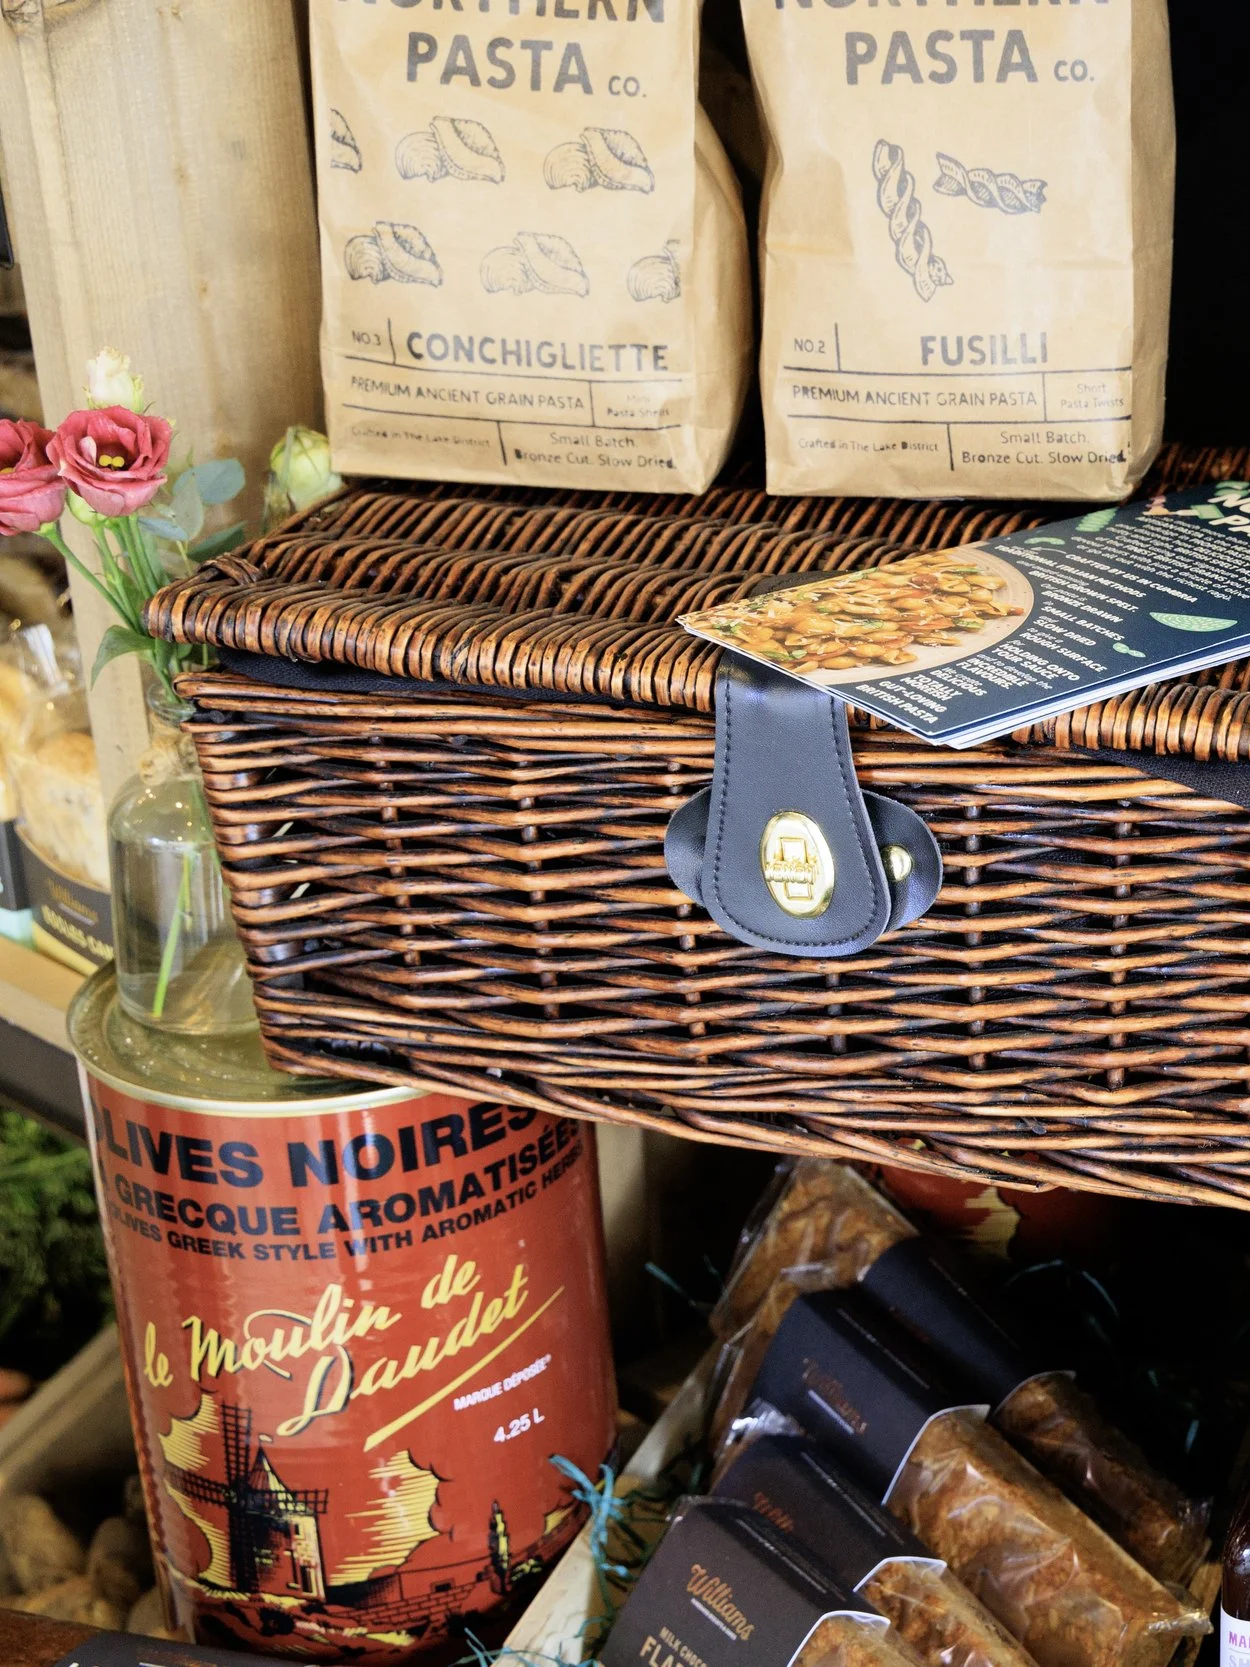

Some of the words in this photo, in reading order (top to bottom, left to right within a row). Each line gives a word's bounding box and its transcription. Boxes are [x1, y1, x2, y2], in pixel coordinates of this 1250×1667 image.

[406, 32, 593, 95] PASTA
[608, 76, 647, 98] CO.
[845, 29, 1038, 85] PASTA
[1054, 60, 1095, 82] CO.
[407, 332, 668, 372] CONCHIGLIETTE
[920, 332, 1048, 366] FUSILLI
[351, 376, 411, 398] PREMIUM
[416, 386, 480, 404] ANCIENT
[486, 391, 534, 407] GRAIN
[538, 395, 585, 410] PASTA
[793, 385, 859, 403] PREMIUM
[865, 391, 931, 406] ANCIENT
[937, 392, 985, 406] GRAIN
[989, 391, 1037, 406] PASTA
[551, 432, 591, 447] Small
[1000, 431, 1041, 445] Small
[599, 455, 632, 467] Slow
[962, 451, 1010, 464] Bronze
[1048, 452, 1083, 464] Slow
[1029, 571, 1068, 585] BRITISH
[1068, 584, 1107, 599] GROWN
[1057, 565, 1096, 579] ITALIAN
[1096, 578, 1146, 597] METHODS
[1066, 554, 1110, 570] CRAFTED
[1107, 567, 1124, 576] BY
[1122, 572, 1138, 581] US
[1149, 584, 1198, 602] CUMBRIA
[1042, 606, 1078, 621] SMALL
[1077, 620, 1124, 640] BATCHES
[1043, 591, 1082, 607] BRONZE
[1081, 606, 1122, 622] DRAWN
[1034, 620, 1066, 633] SLOW
[1064, 632, 1096, 646] DRIED
[991, 649, 1023, 662] YOUR
[1021, 662, 1057, 679] SAUCE
[1001, 644, 1048, 665] HOLDING
[1047, 665, 1081, 681] ONTO
[1021, 633, 1059, 649] ROUGH
[1057, 648, 1107, 672] SURFACE
[914, 675, 961, 697] TOTALLY
[932, 670, 987, 696] DELICIOUS
[957, 662, 1014, 689] FLAVOURS.
[969, 658, 1027, 686] INCREDIBLE
[857, 684, 903, 705] BRITISH
[900, 703, 940, 723] PASTA
[880, 681, 947, 713] GUT-LOVING
[901, 678, 950, 700] MOREISH
[287, 1102, 537, 1188] NOIRES
[114, 1172, 300, 1236] GRECQUE
[167, 1231, 247, 1261] GREEK
[253, 1242, 337, 1261] STYLE
[344, 1229, 413, 1257] WITH
[421, 1180, 538, 1243] AROMATIC
[143, 1321, 173, 1387] le
[181, 1283, 402, 1381] Moulin
[420, 1253, 481, 1310] de
[277, 1262, 530, 1438] Daudet
[494, 1413, 531, 1442] 4.25
[533, 1407, 545, 1424] L
[686, 1564, 755, 1641] Williams
[658, 1626, 683, 1651] MILK
